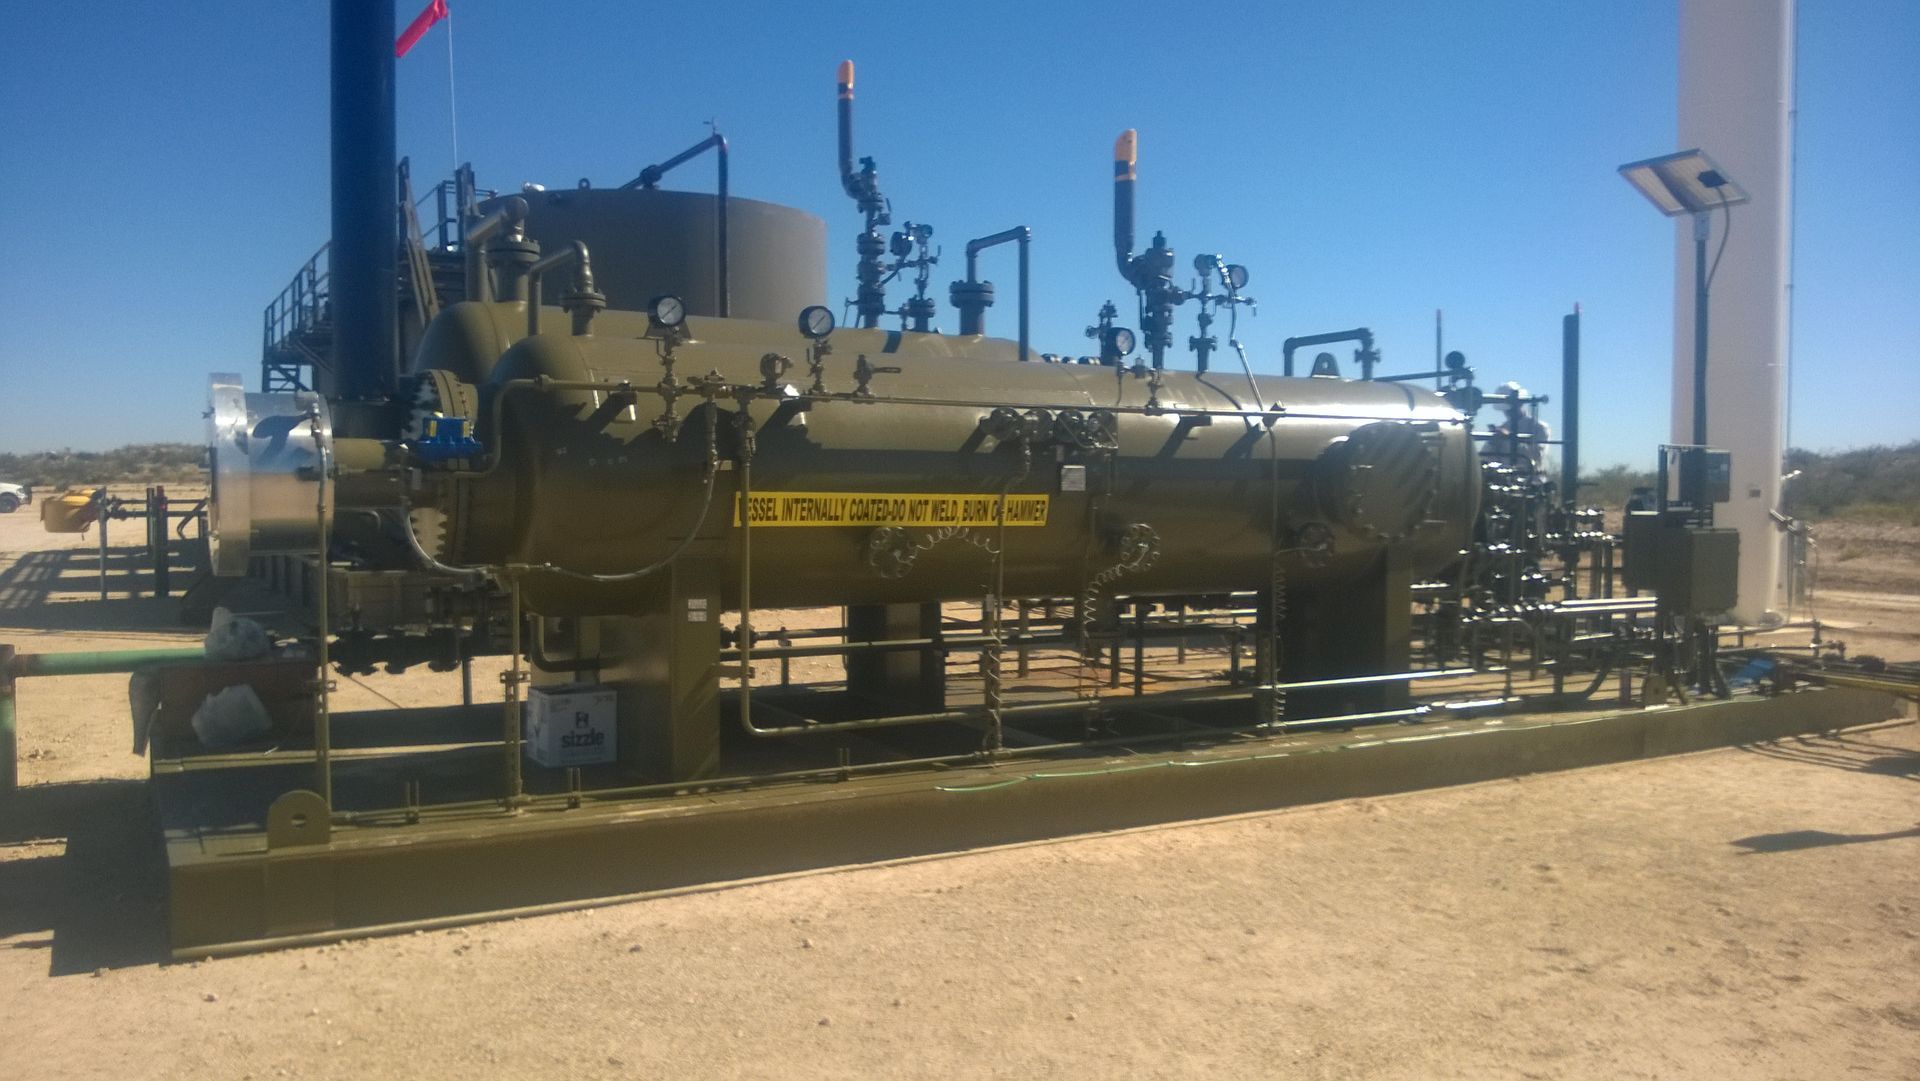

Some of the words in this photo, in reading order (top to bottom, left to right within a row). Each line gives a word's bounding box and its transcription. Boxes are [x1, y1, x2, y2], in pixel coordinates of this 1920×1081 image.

[738, 498, 777, 521] ESSEL
[781, 498, 847, 521] INTERNALLY
[908, 499, 928, 521] NOT
[962, 500, 989, 521] BURN
[991, 500, 1004, 521] O
[1005, 500, 1046, 521] HAMMER
[561, 728, 604, 748] sizzle
